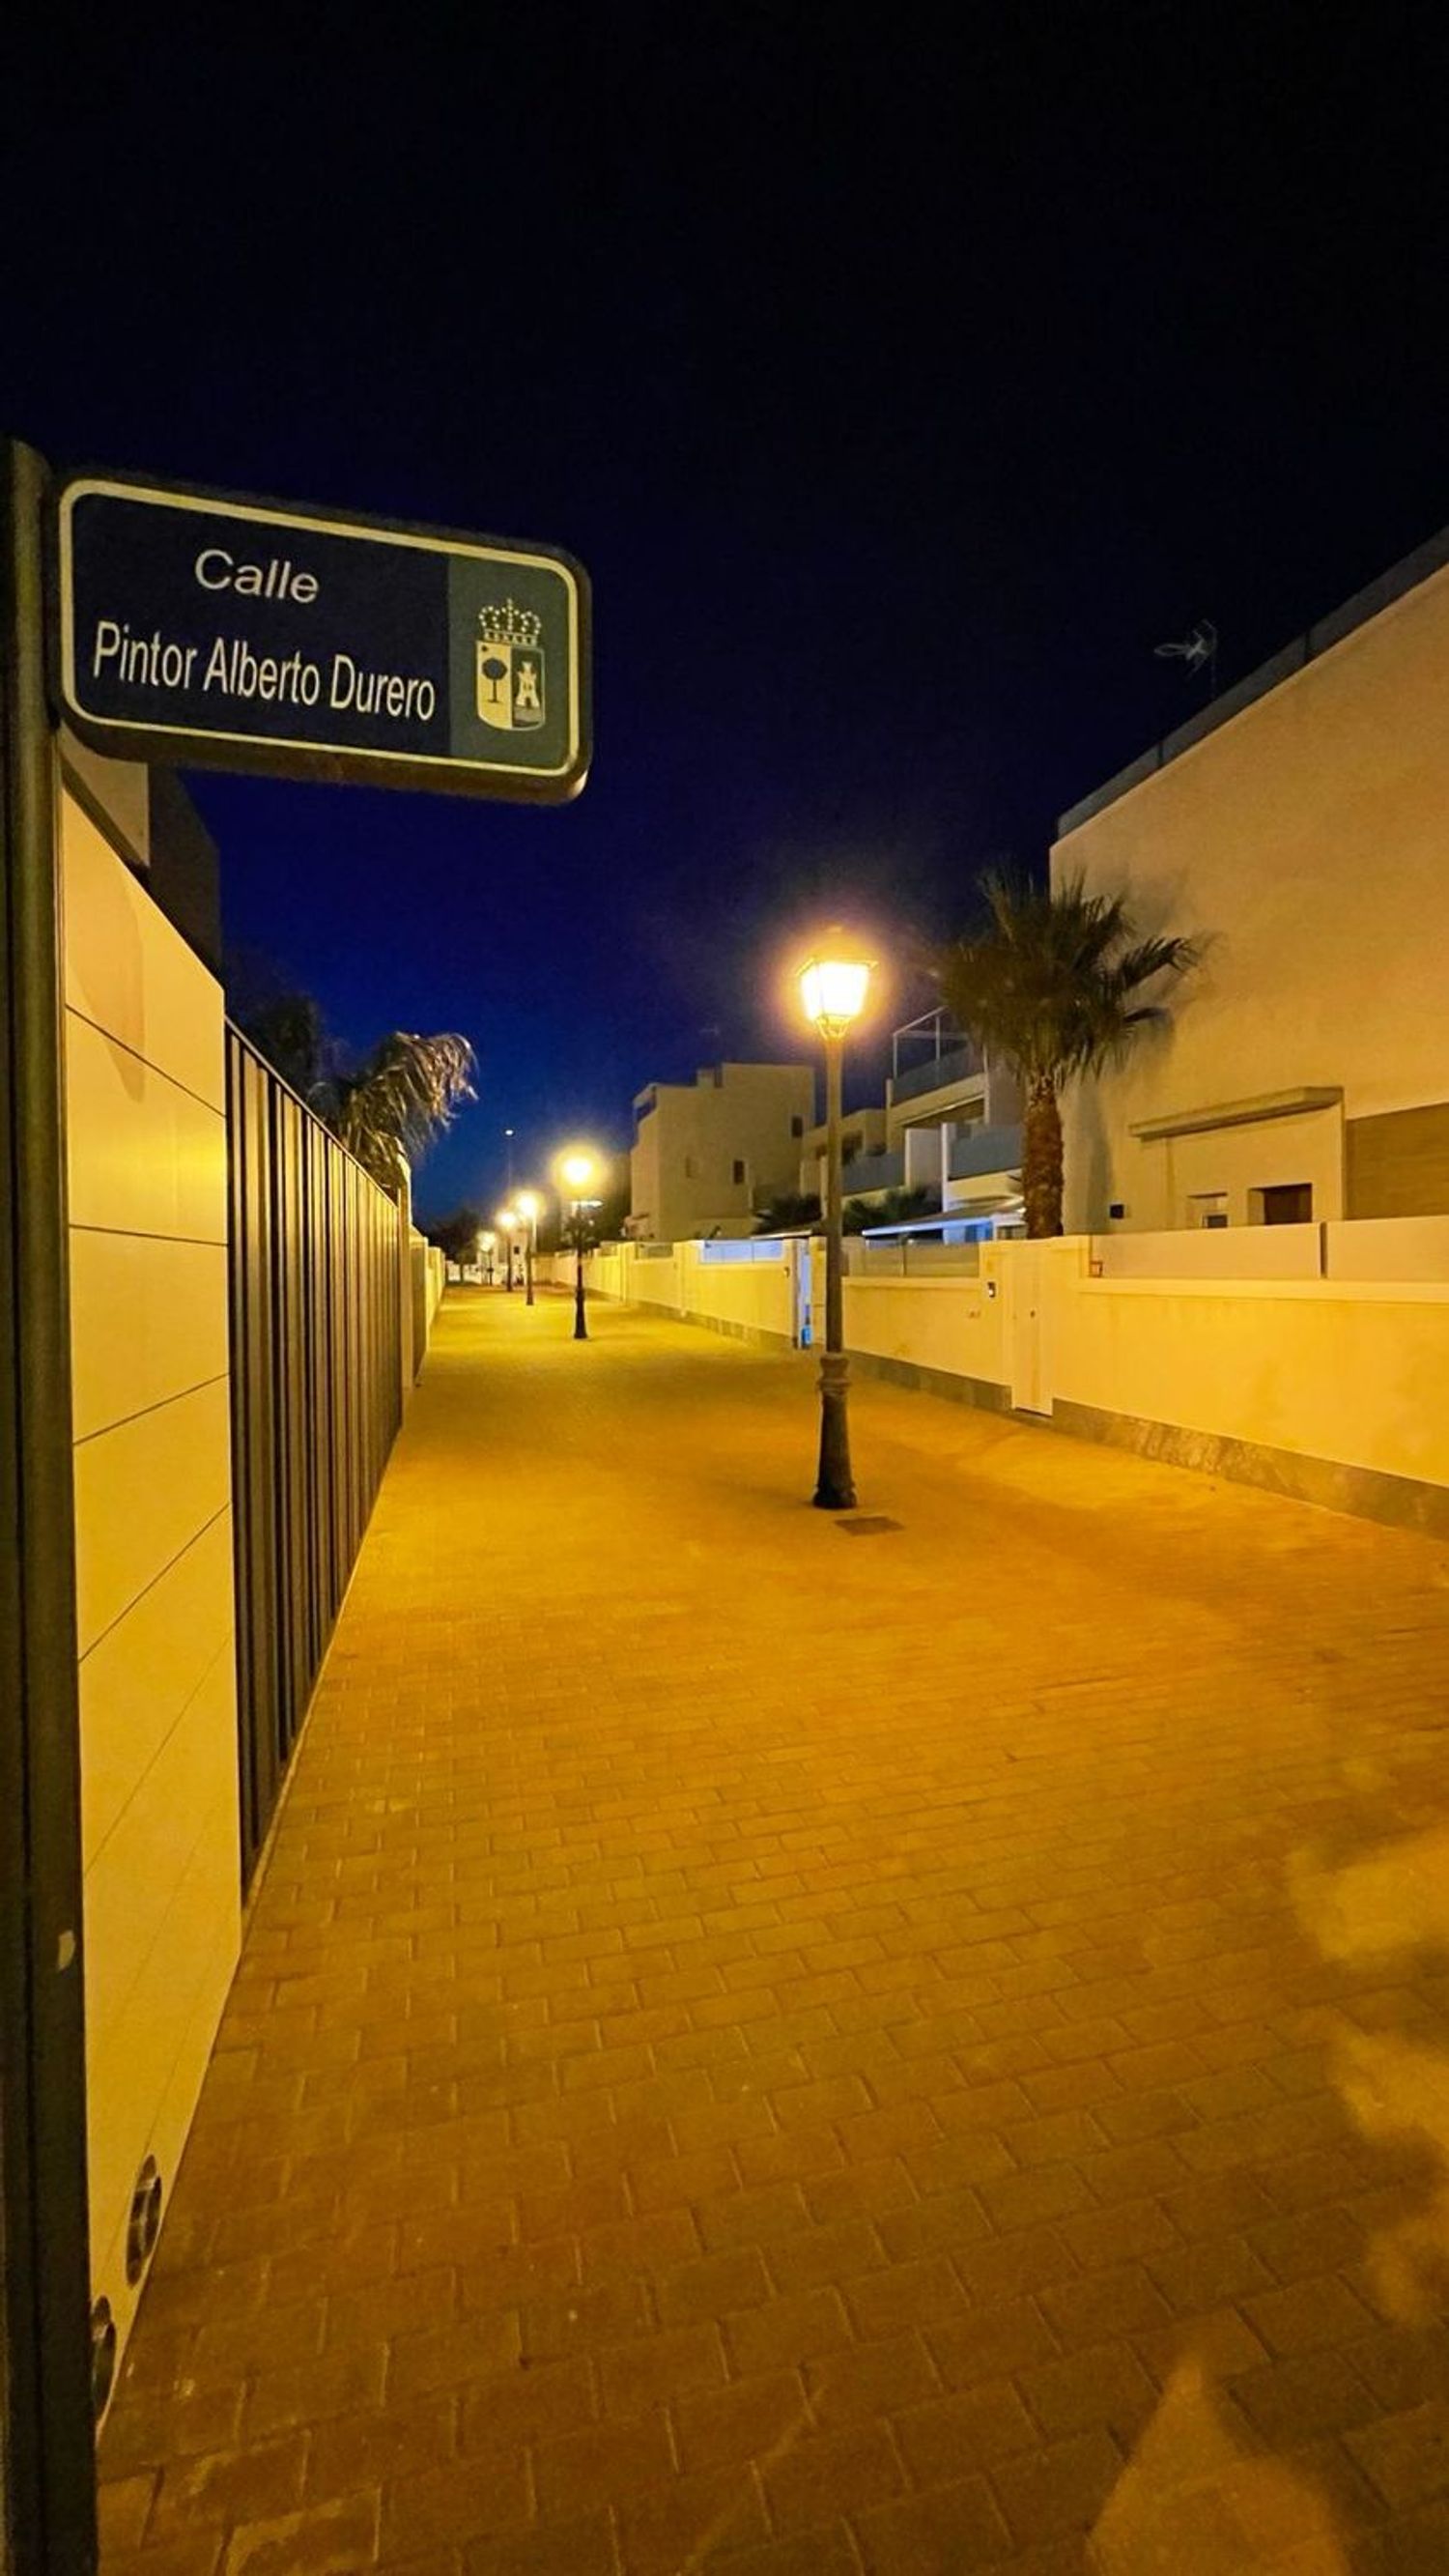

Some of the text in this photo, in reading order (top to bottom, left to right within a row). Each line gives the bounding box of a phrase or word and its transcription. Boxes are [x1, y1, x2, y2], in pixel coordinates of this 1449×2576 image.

[194, 548, 320, 605] Calle
[93, 620, 437, 721] Pintor Alberto Durero
